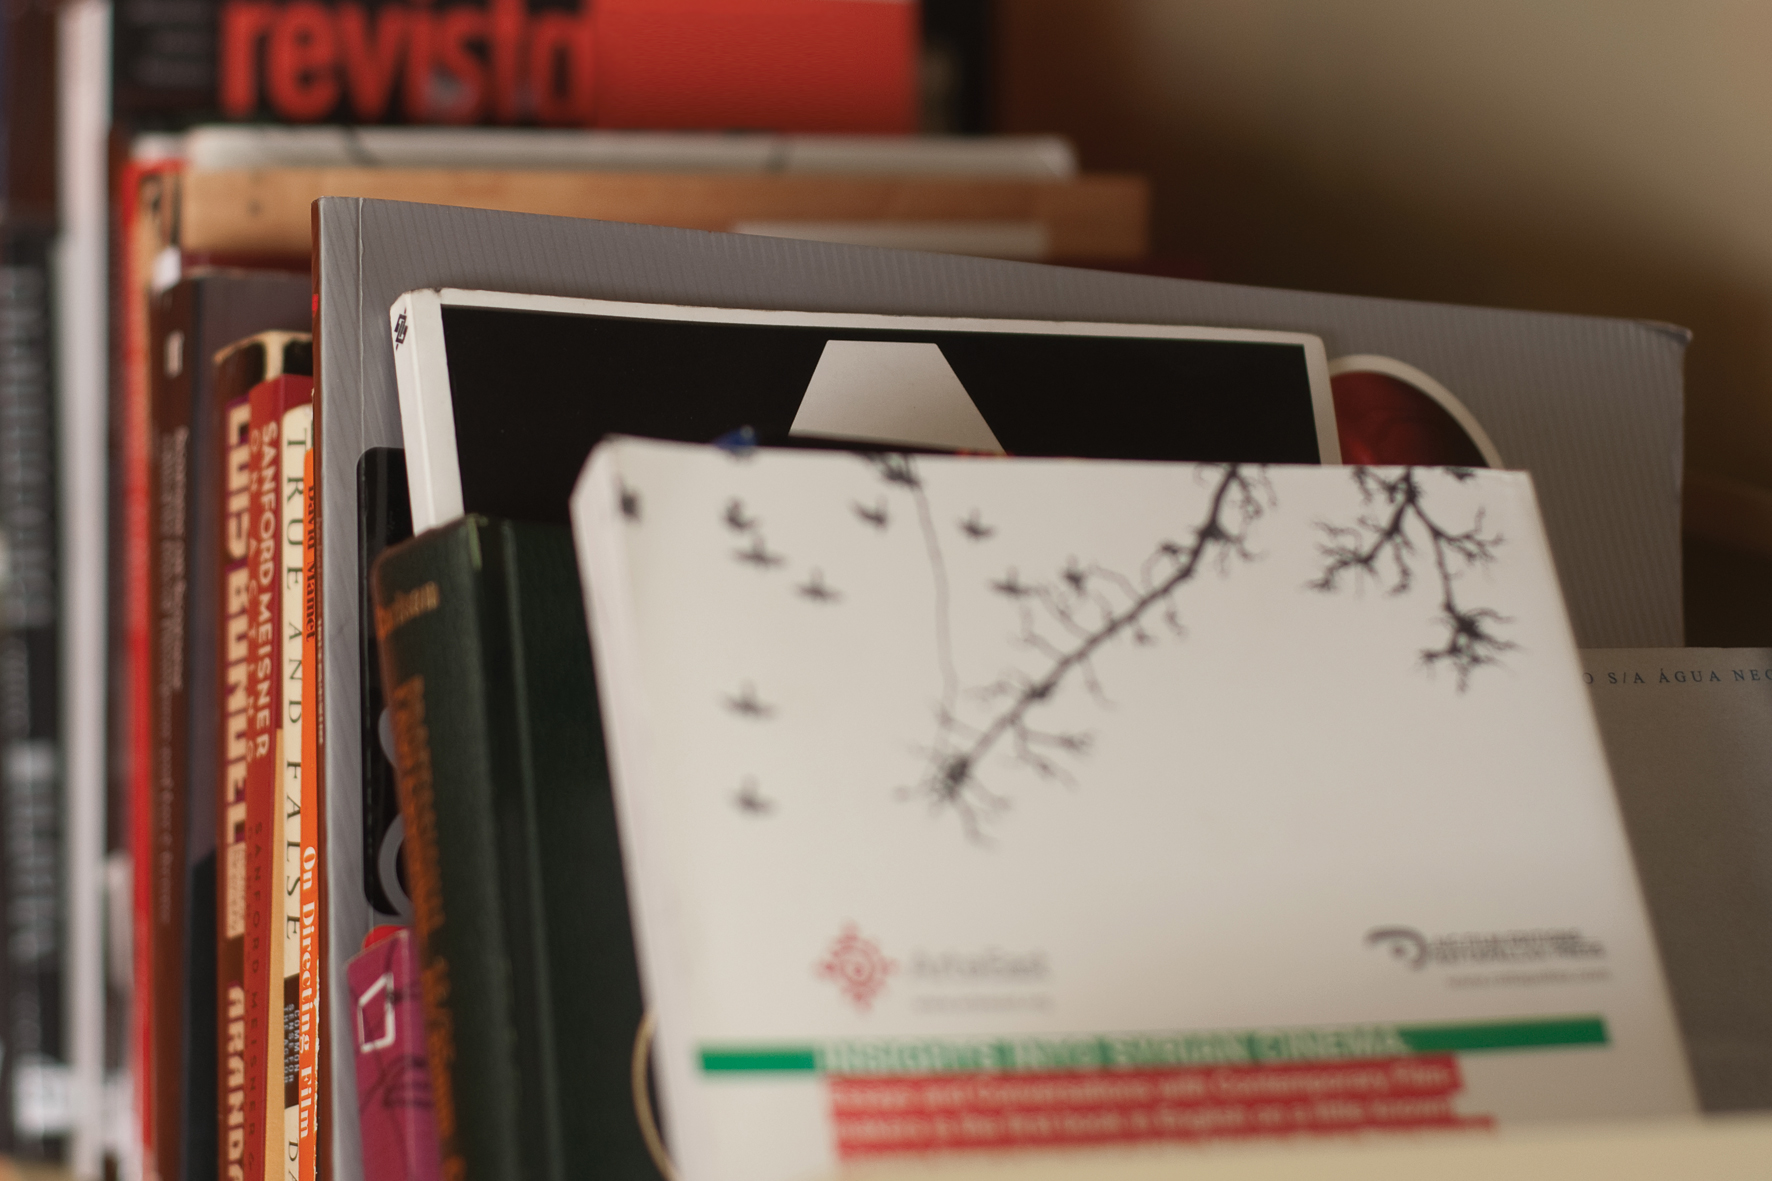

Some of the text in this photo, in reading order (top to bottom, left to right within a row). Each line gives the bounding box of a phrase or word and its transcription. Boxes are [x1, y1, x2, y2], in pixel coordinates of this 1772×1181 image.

[226, 401, 250, 560] LUIS
[247, 429, 260, 763] ON ACTING
[254, 420, 278, 758] SANFORD MEISNER
[304, 485, 315, 642] David Mamet
[286, 428, 308, 940] TRUE AND FALSE
[1658, 668, 1722, 684] ÁGUA
[251, 821, 263, 974] SANFORD
[248, 991, 259, 1136] MEISNER
[300, 846, 316, 1138] On Directing Film
